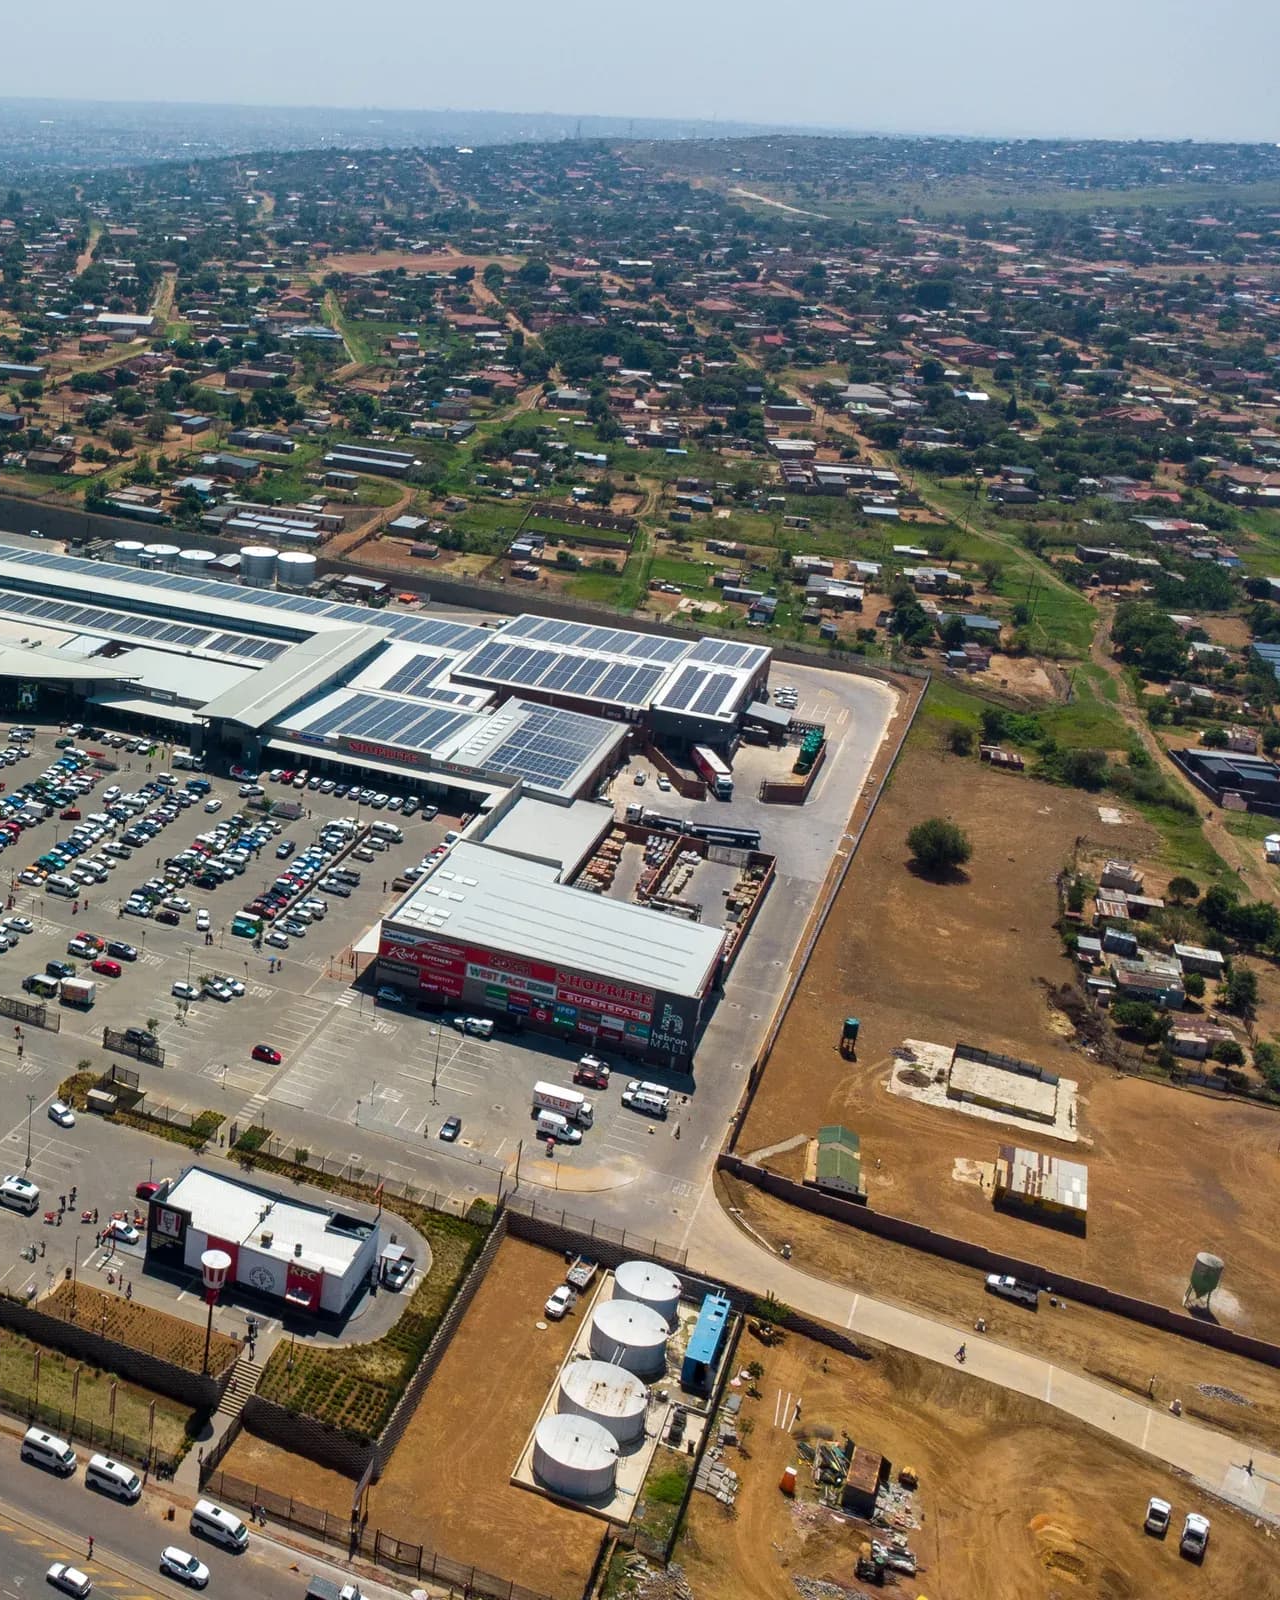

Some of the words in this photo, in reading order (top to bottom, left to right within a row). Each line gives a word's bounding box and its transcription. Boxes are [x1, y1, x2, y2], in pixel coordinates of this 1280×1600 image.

[348, 742, 419, 764] SHOPRITE
[469, 965, 498, 982] WEST
[500, 973, 526, 989] PACK
[558, 972, 653, 1006] SHOPRITE
[560, 1005, 576, 1016] PEP
[567, 993, 639, 1017] SUPERSPAR
[373, 1021, 397, 1036] STOP
[650, 1038, 687, 1056] MALL
[652, 1029, 688, 1047] hebron
[290, 1266, 317, 1282] KFC
